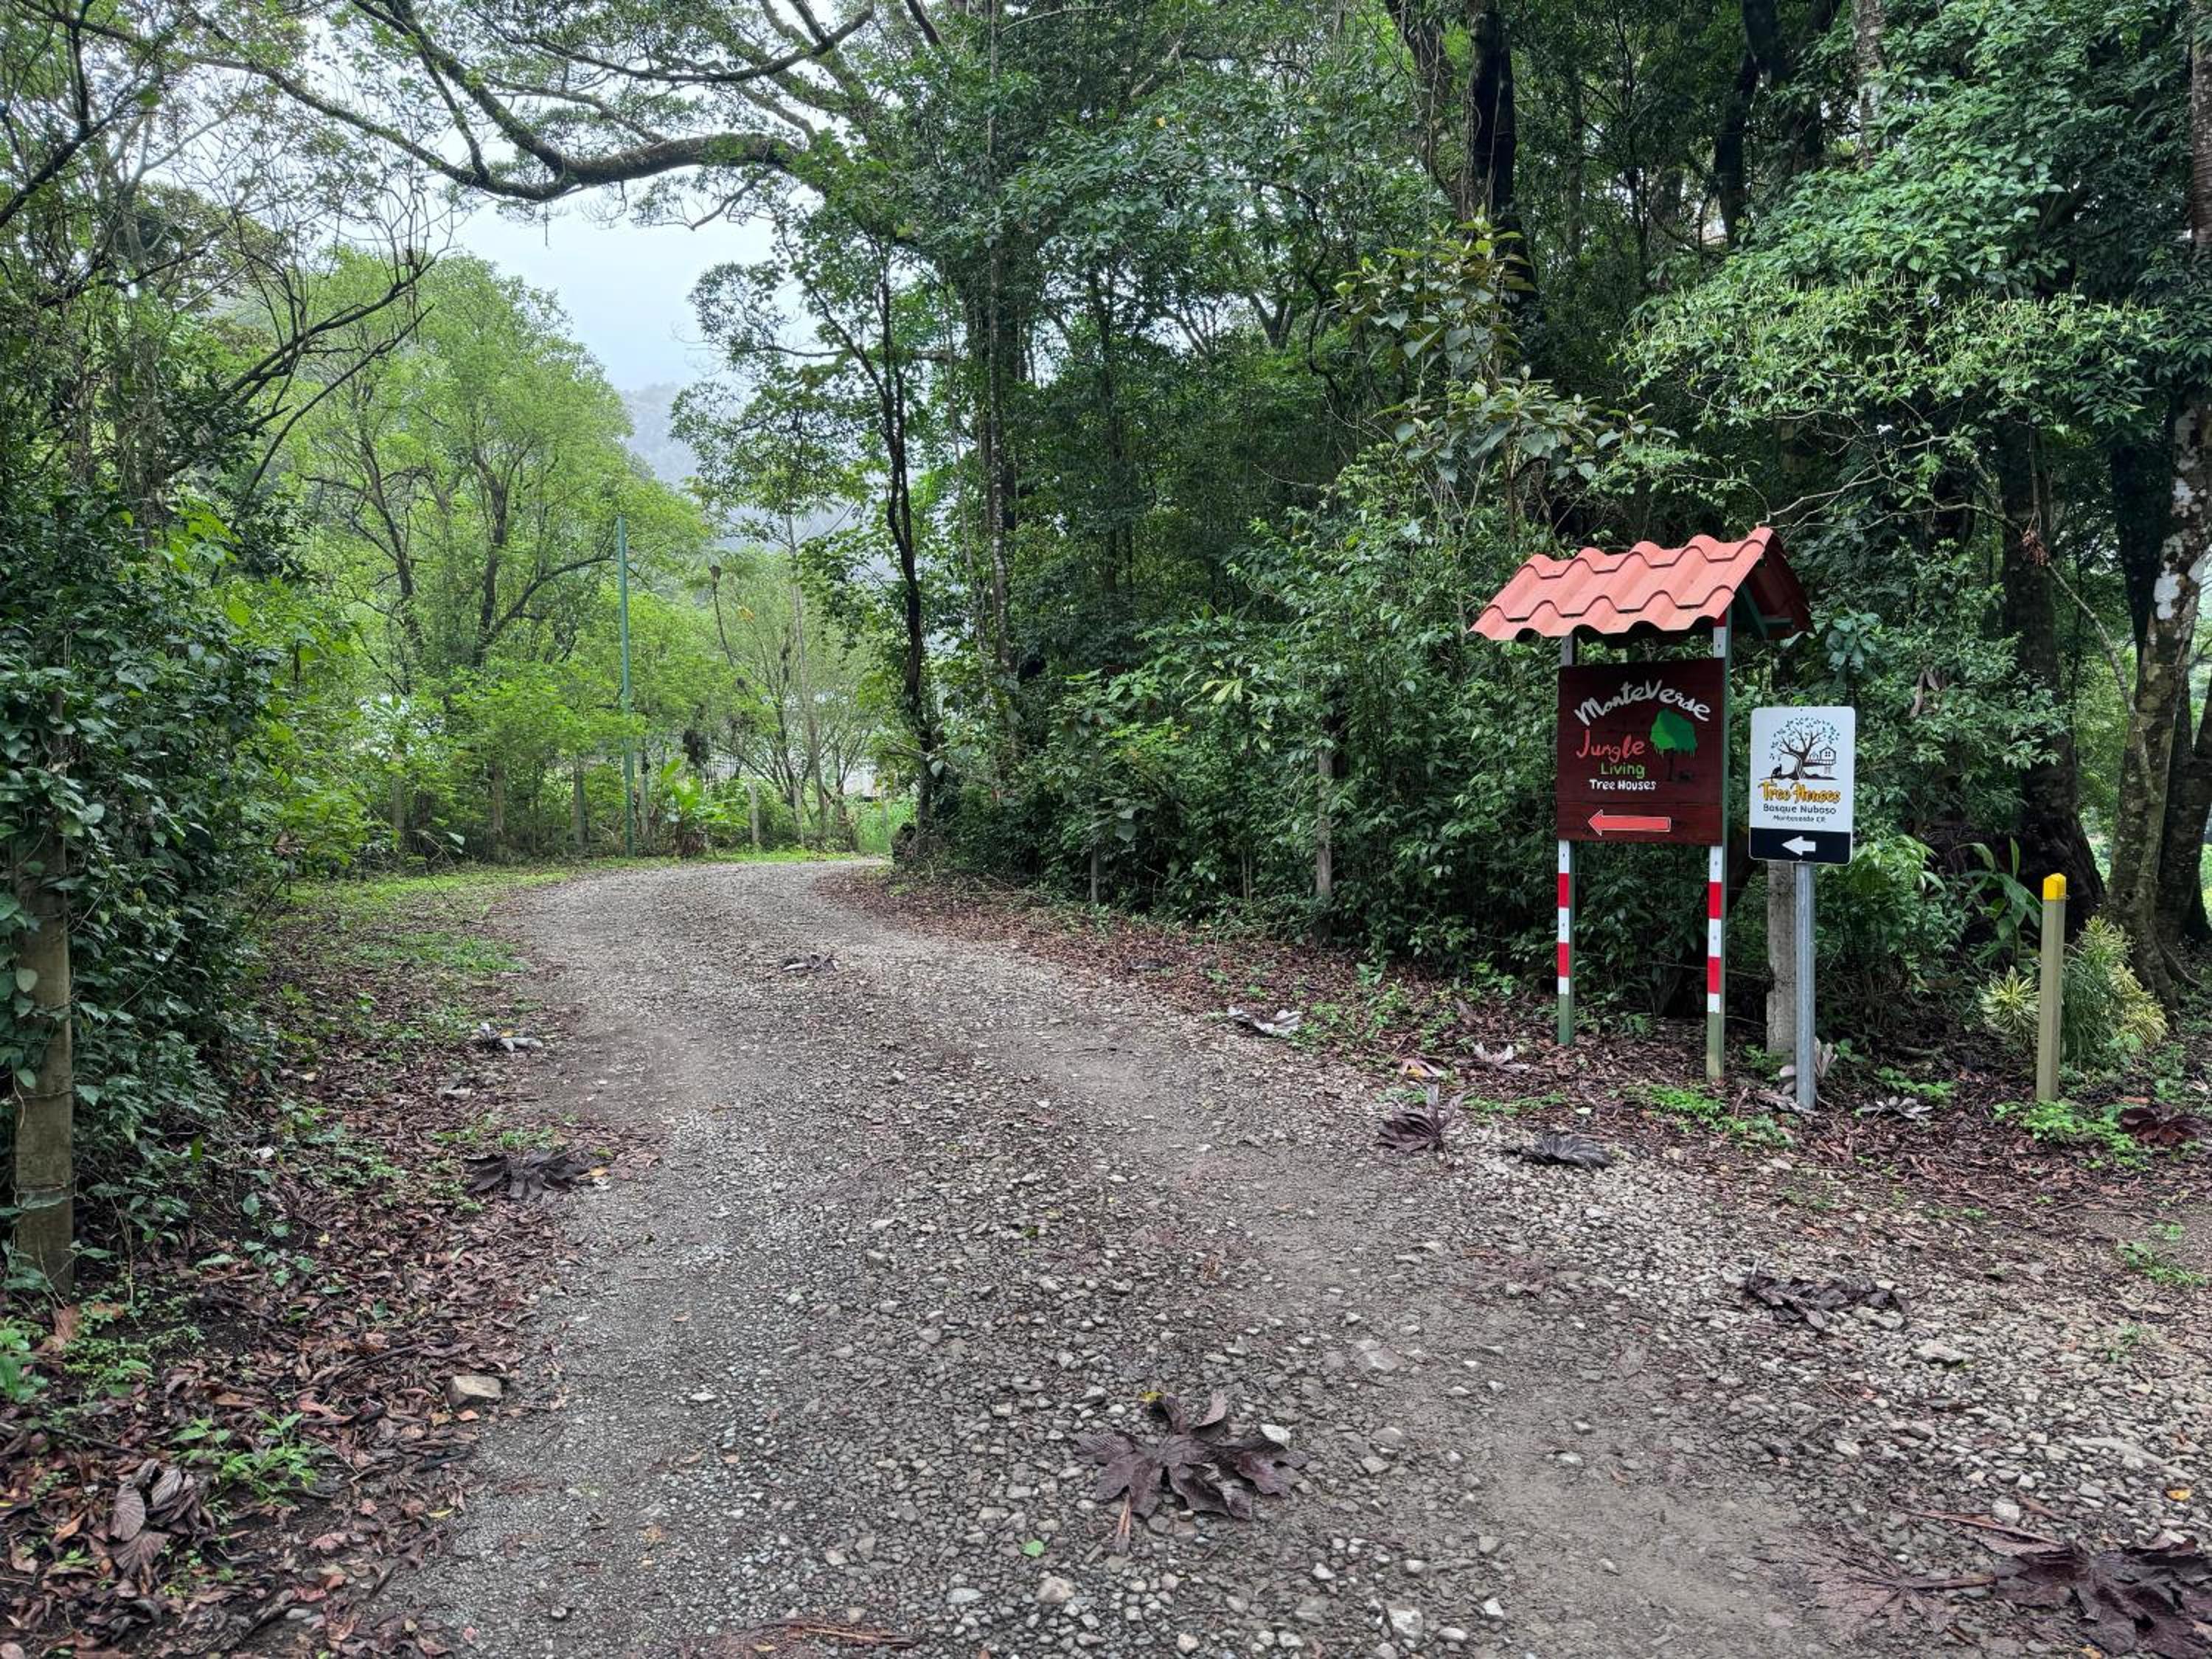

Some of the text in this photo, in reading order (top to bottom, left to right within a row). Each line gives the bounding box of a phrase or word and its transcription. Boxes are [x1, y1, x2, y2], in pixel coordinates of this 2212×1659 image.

[1576, 729, 1645, 763] Jungle
[1601, 762, 1645, 779] Living
[1589, 779, 1657, 790] Tree Houses
[1763, 803, 1837, 815] Bosque Nuboso
